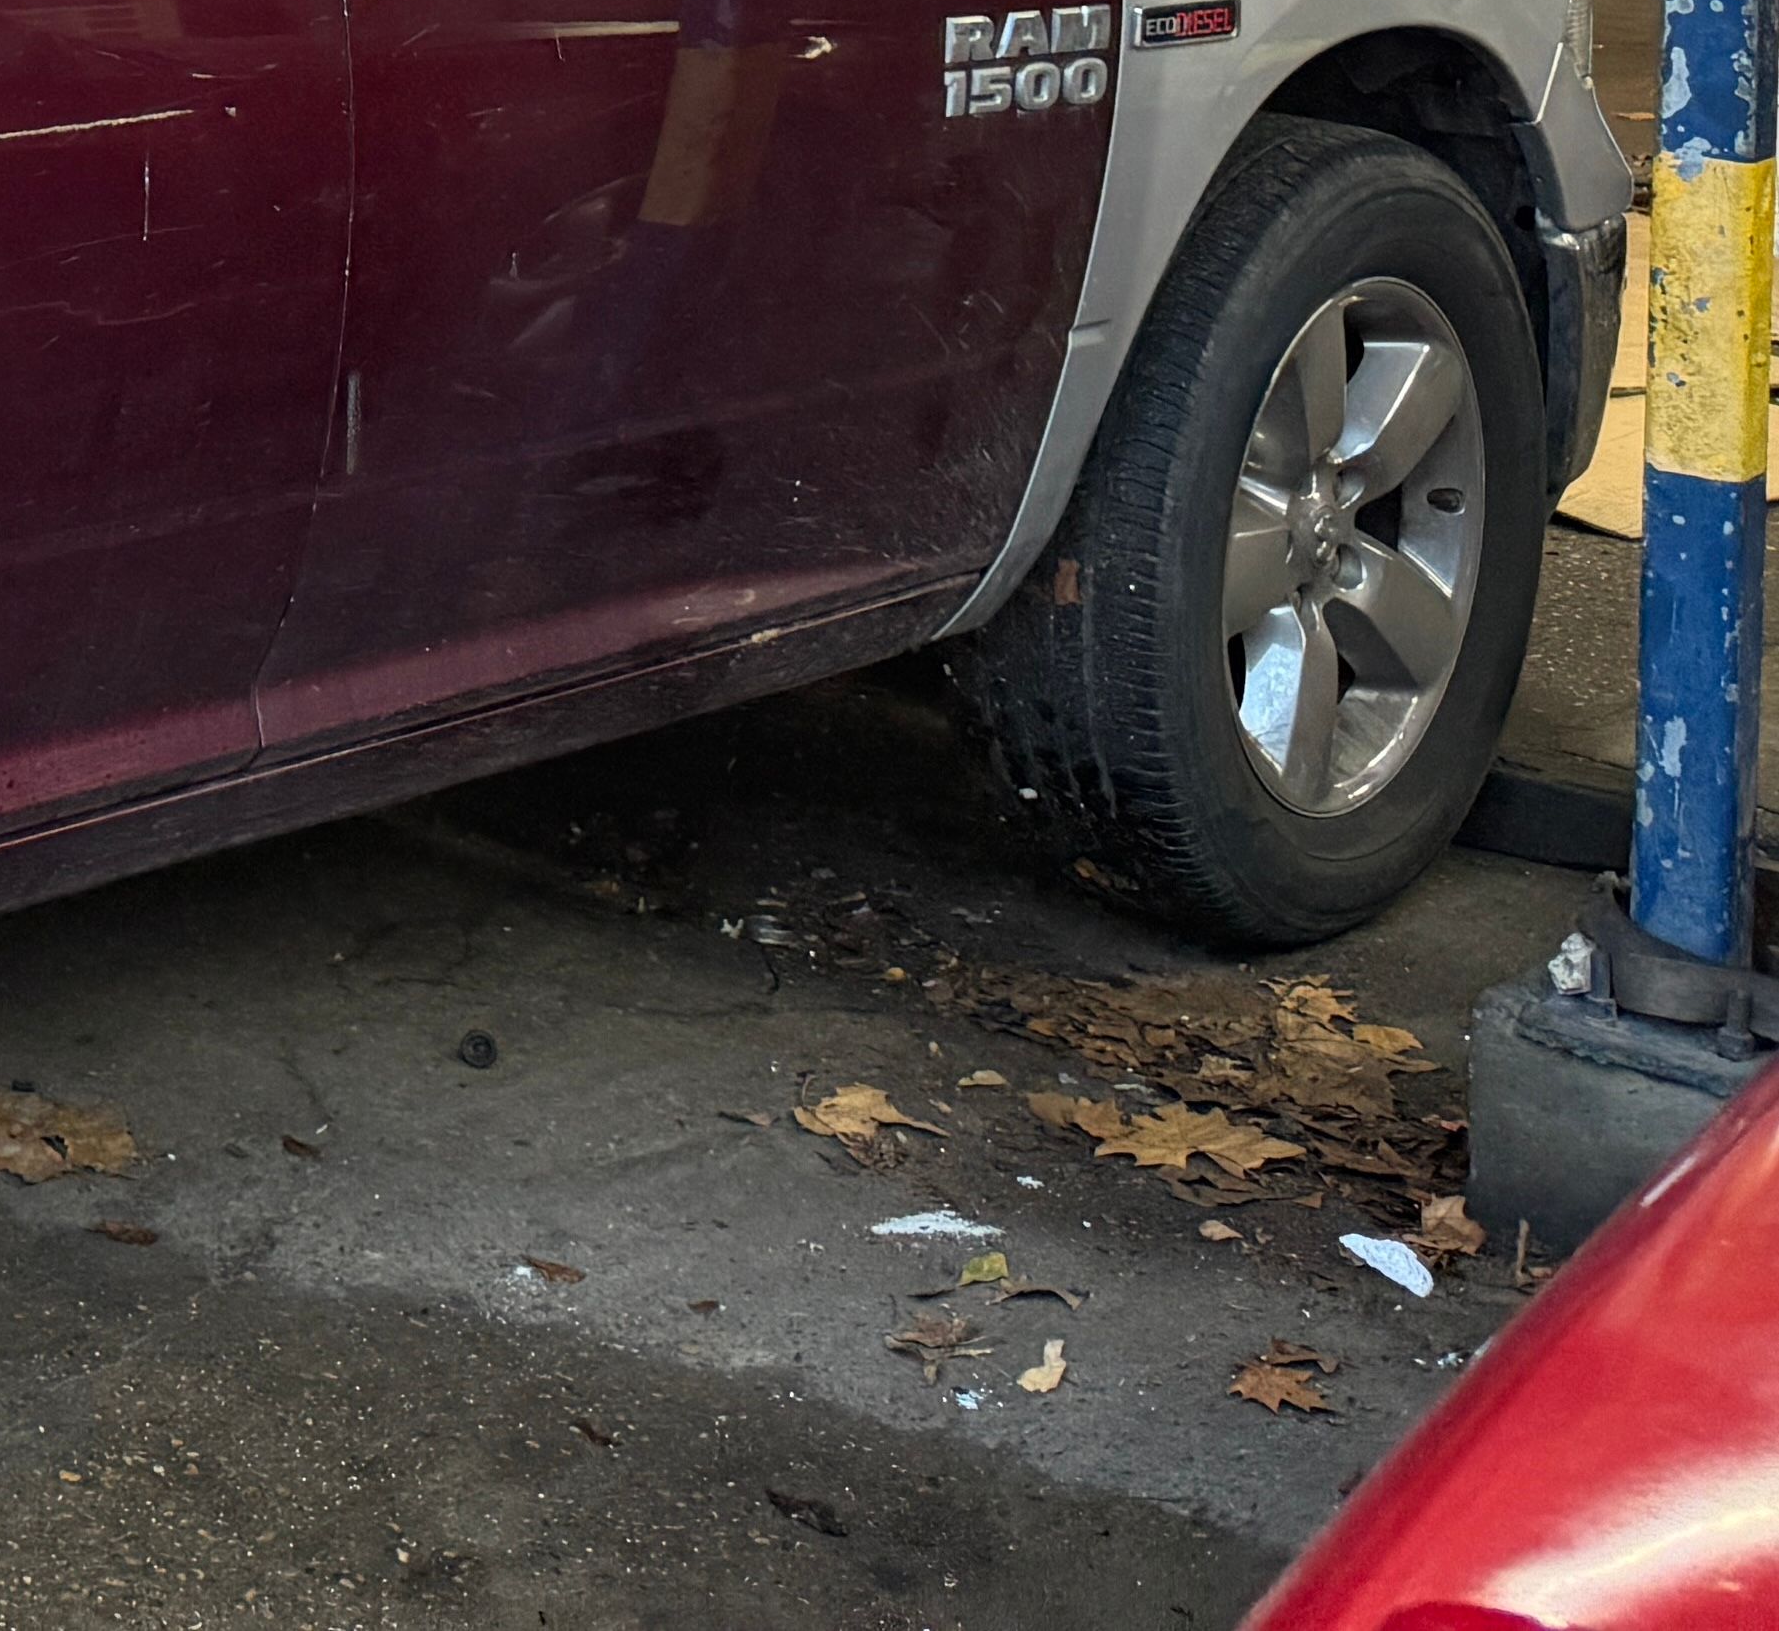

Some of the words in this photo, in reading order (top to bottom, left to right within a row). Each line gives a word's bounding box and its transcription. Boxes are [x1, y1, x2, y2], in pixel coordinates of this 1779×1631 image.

[944, 4, 1111, 63] RAM
[1146, 7, 1232, 36] ECODIESEL
[944, 57, 1109, 117] 1500
